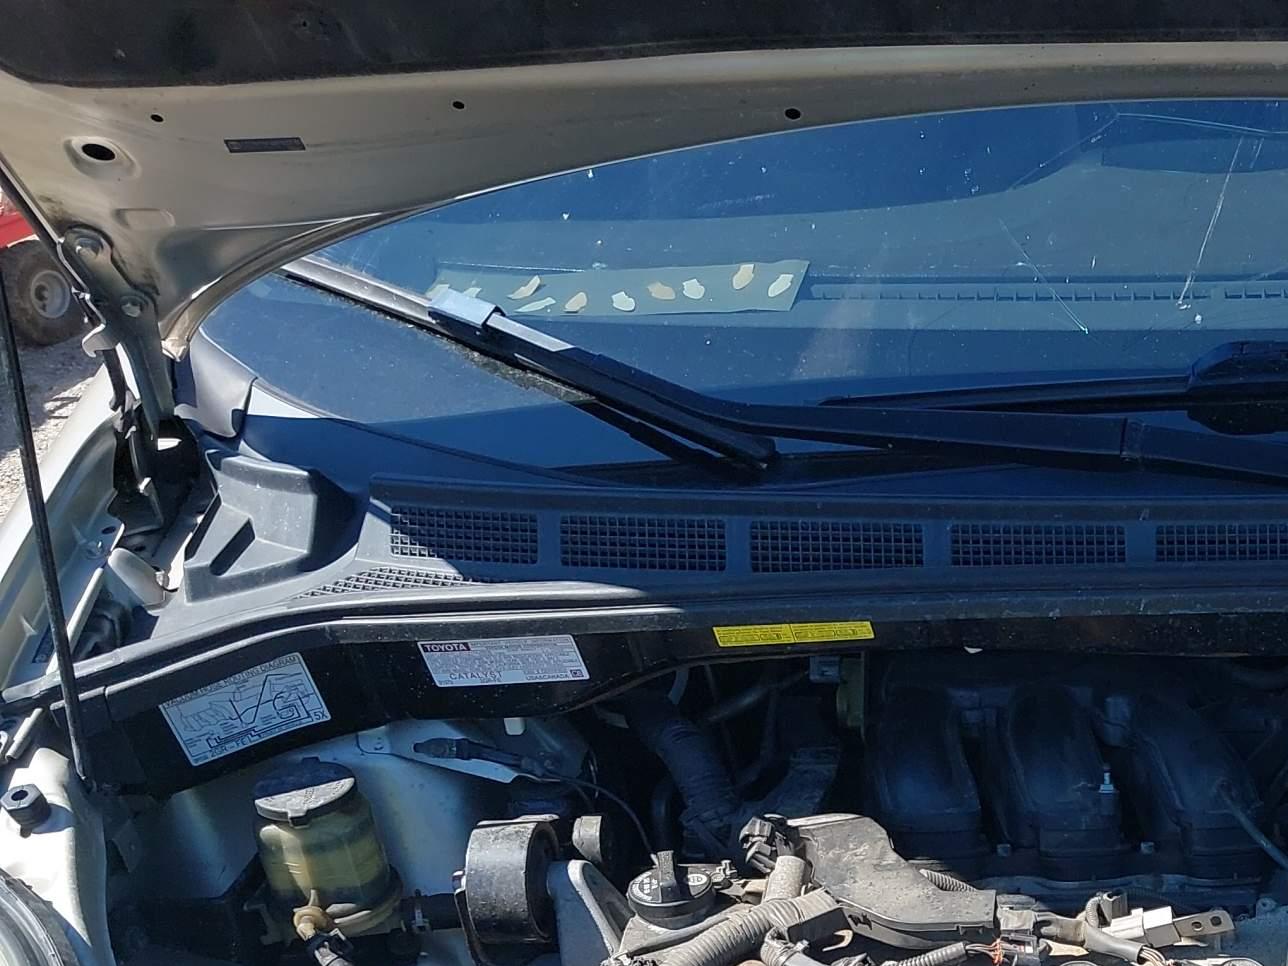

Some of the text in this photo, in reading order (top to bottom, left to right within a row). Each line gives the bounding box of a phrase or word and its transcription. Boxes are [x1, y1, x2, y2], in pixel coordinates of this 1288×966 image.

[424, 643, 468, 653] TOYOTA
[261, 656, 298, 674] DIAGRAM
[449, 671, 502, 681] CATALYST
[313, 710, 329, 722] 5X
